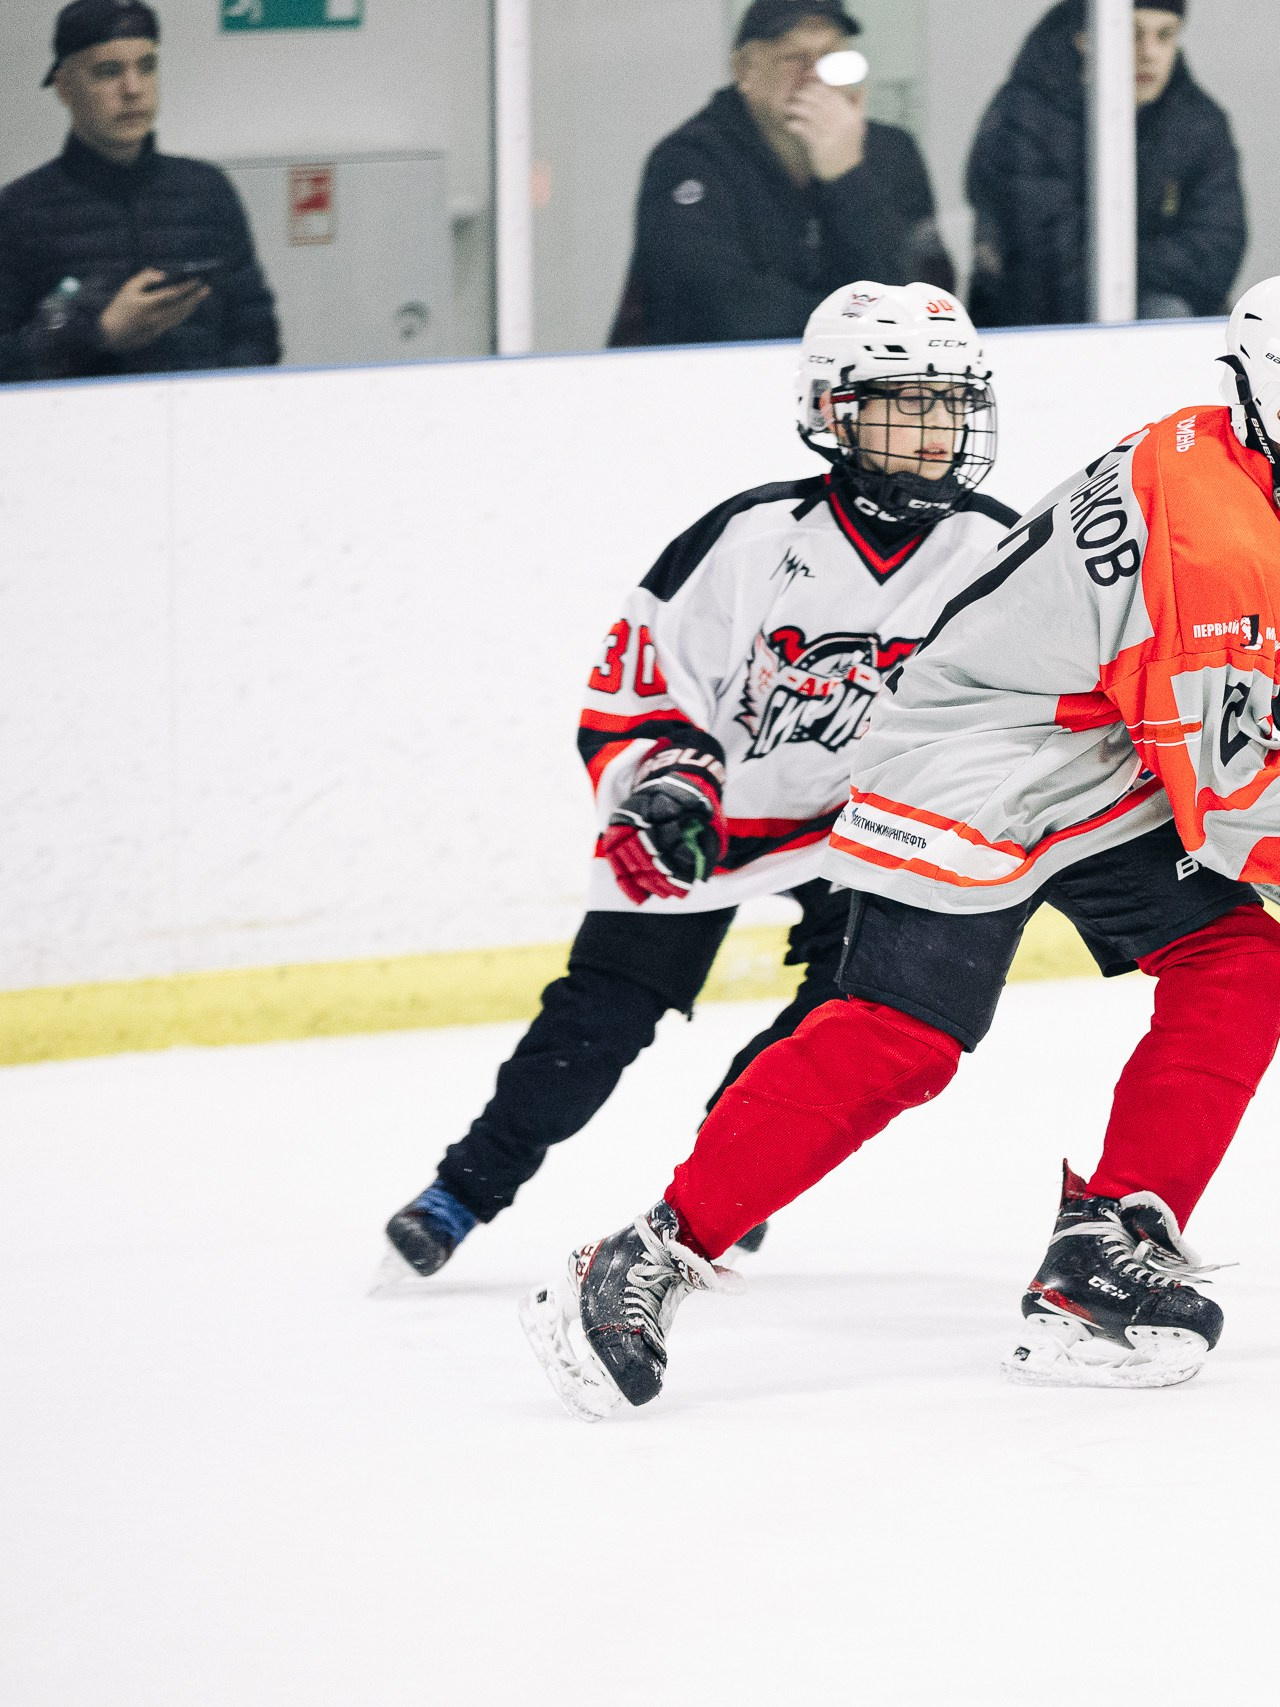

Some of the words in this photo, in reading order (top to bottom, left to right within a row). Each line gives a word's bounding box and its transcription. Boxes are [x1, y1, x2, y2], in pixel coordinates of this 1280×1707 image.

[928, 339, 968, 348] CCM
[809, 355, 836, 364] CCM
[1193, 619, 1241, 639] ПЕРВЫЙ
[588, 618, 667, 698] 30
[1088, 1275, 1131, 1300] CCM
